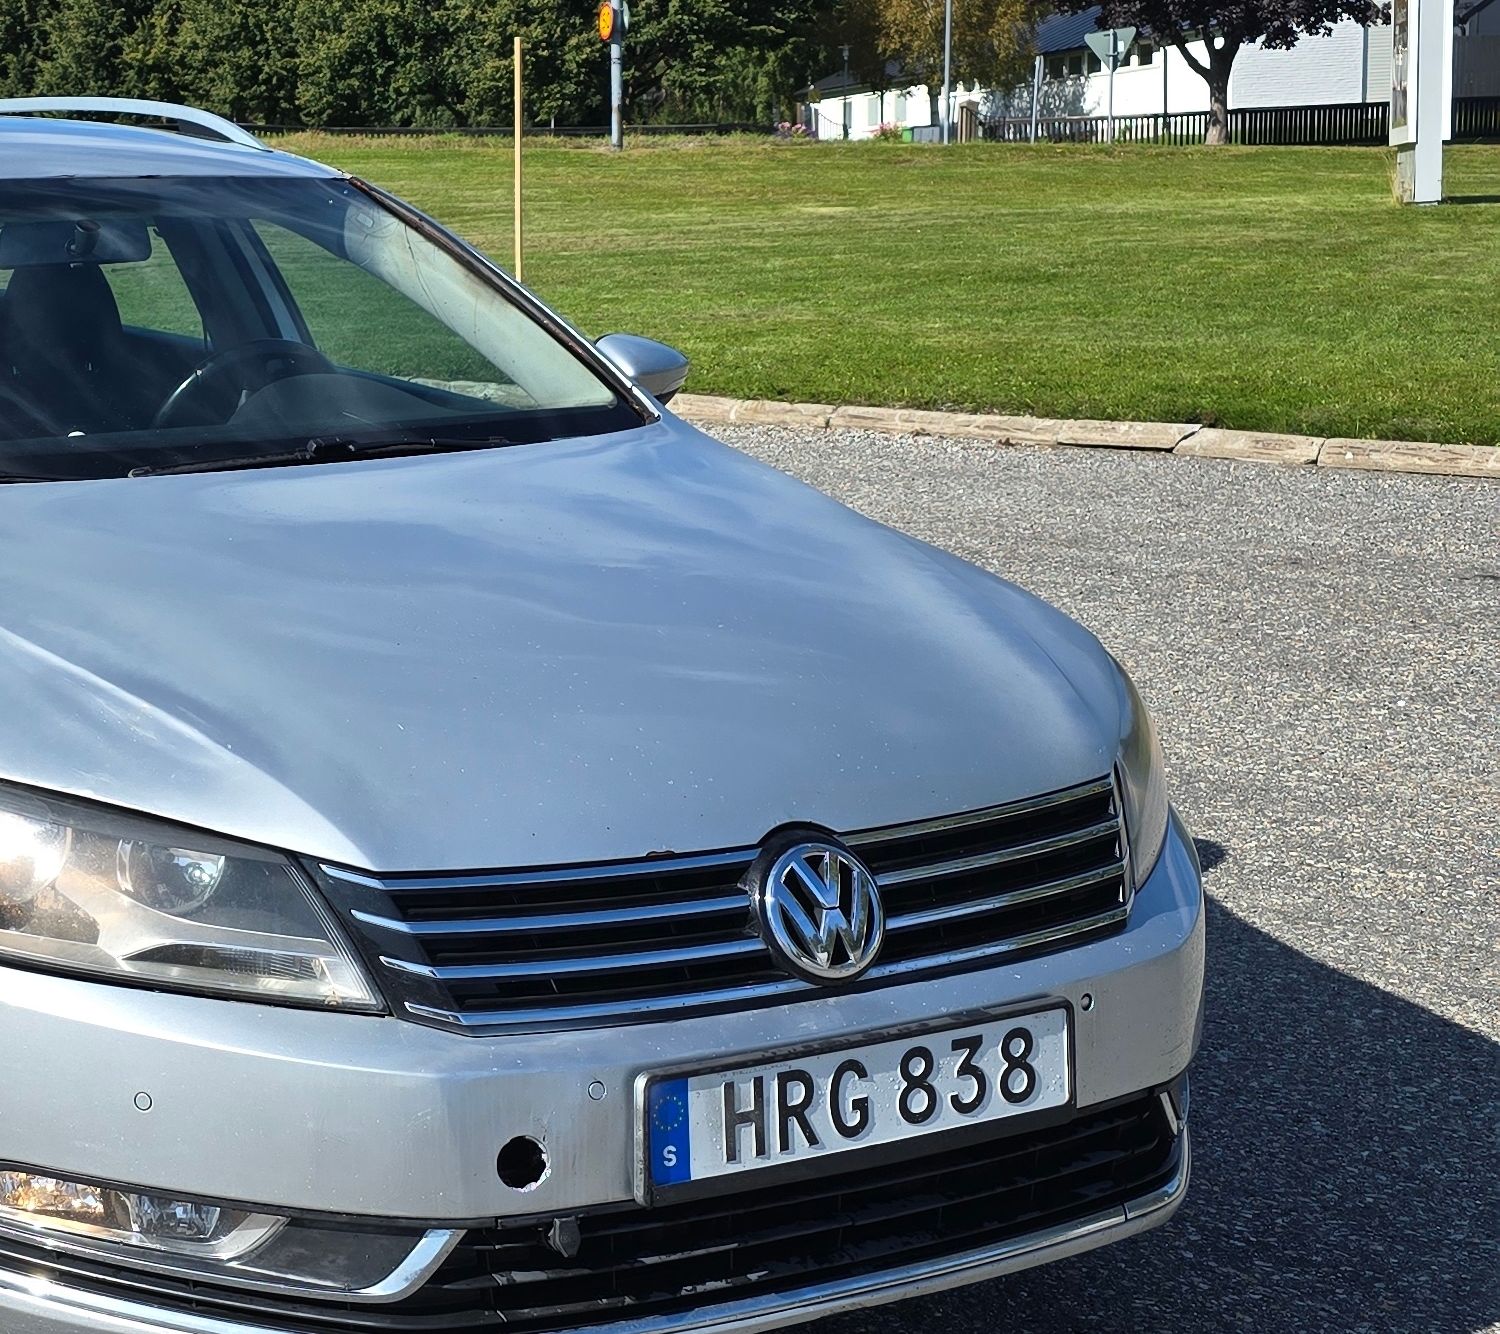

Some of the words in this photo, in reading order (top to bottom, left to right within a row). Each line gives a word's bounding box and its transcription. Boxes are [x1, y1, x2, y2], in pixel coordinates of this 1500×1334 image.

[722, 1058, 870, 1163] HRG
[898, 1027, 1037, 1124] 838
[663, 1145, 677, 1167] S
